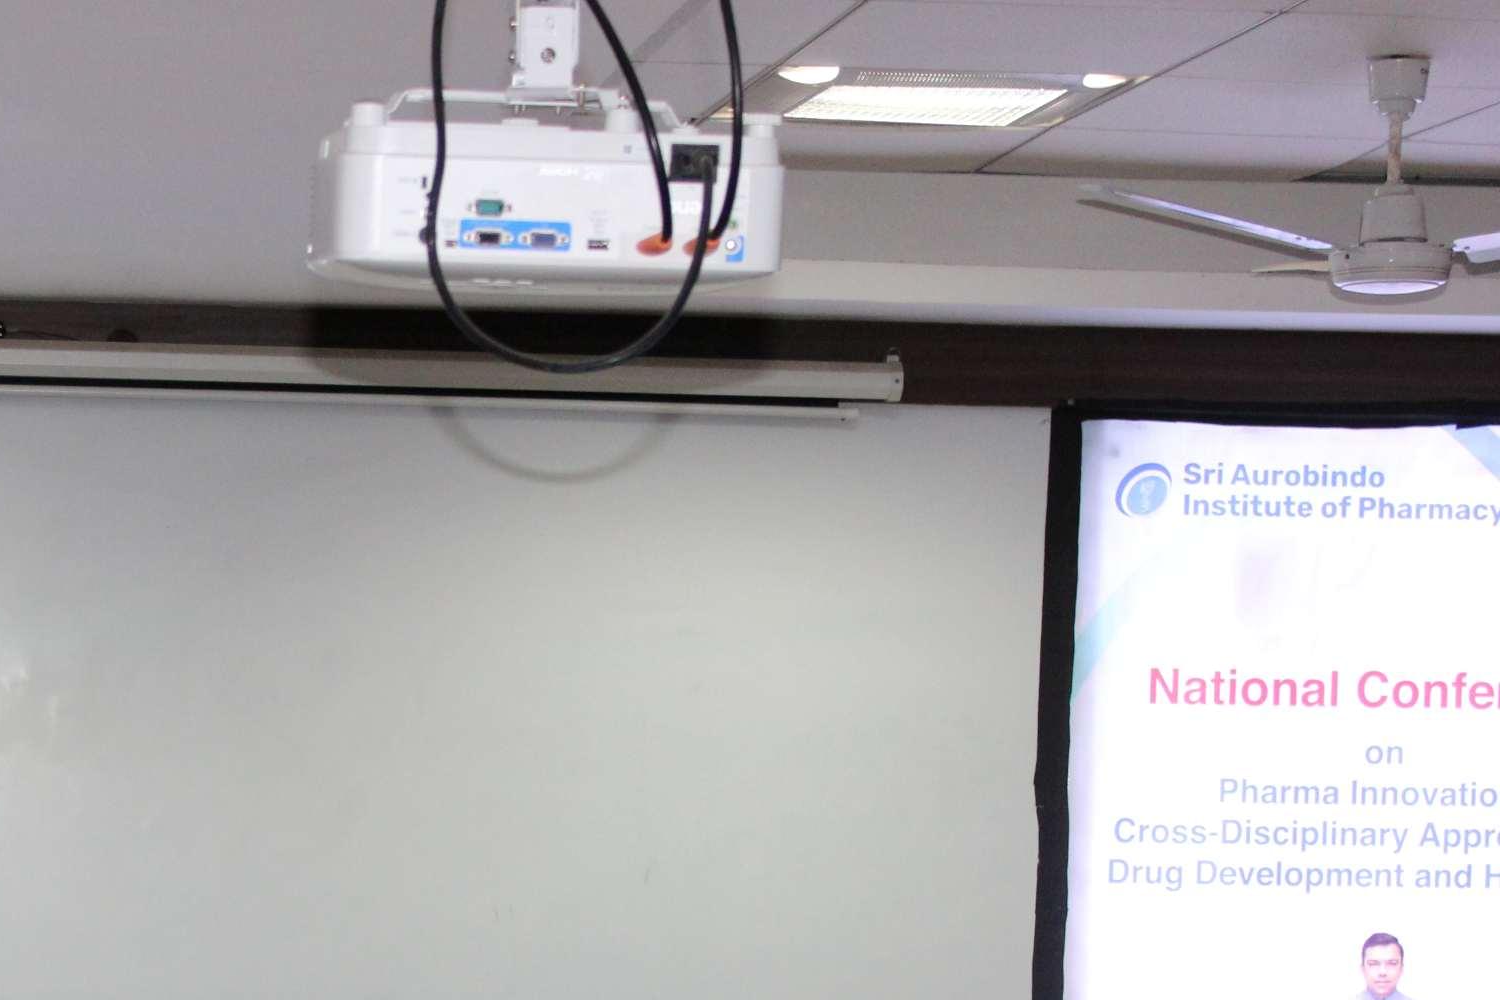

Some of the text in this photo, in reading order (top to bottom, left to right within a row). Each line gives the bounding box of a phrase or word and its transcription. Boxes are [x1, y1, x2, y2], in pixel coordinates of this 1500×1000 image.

[1184, 463, 1385, 488] Sri Aurobindo
[1184, 494, 1500, 526] Institute of Pharmacy
[1150, 668, 1500, 709] National Confe
[1365, 745, 1403, 764] on
[1220, 778, 1339, 804] Pharma
[1114, 817, 1500, 854] Cross-Disciplinary Appr
[1108, 859, 1182, 891] Drug
[1196, 860, 1404, 893] Development
[1415, 864, 1472, 888] and
